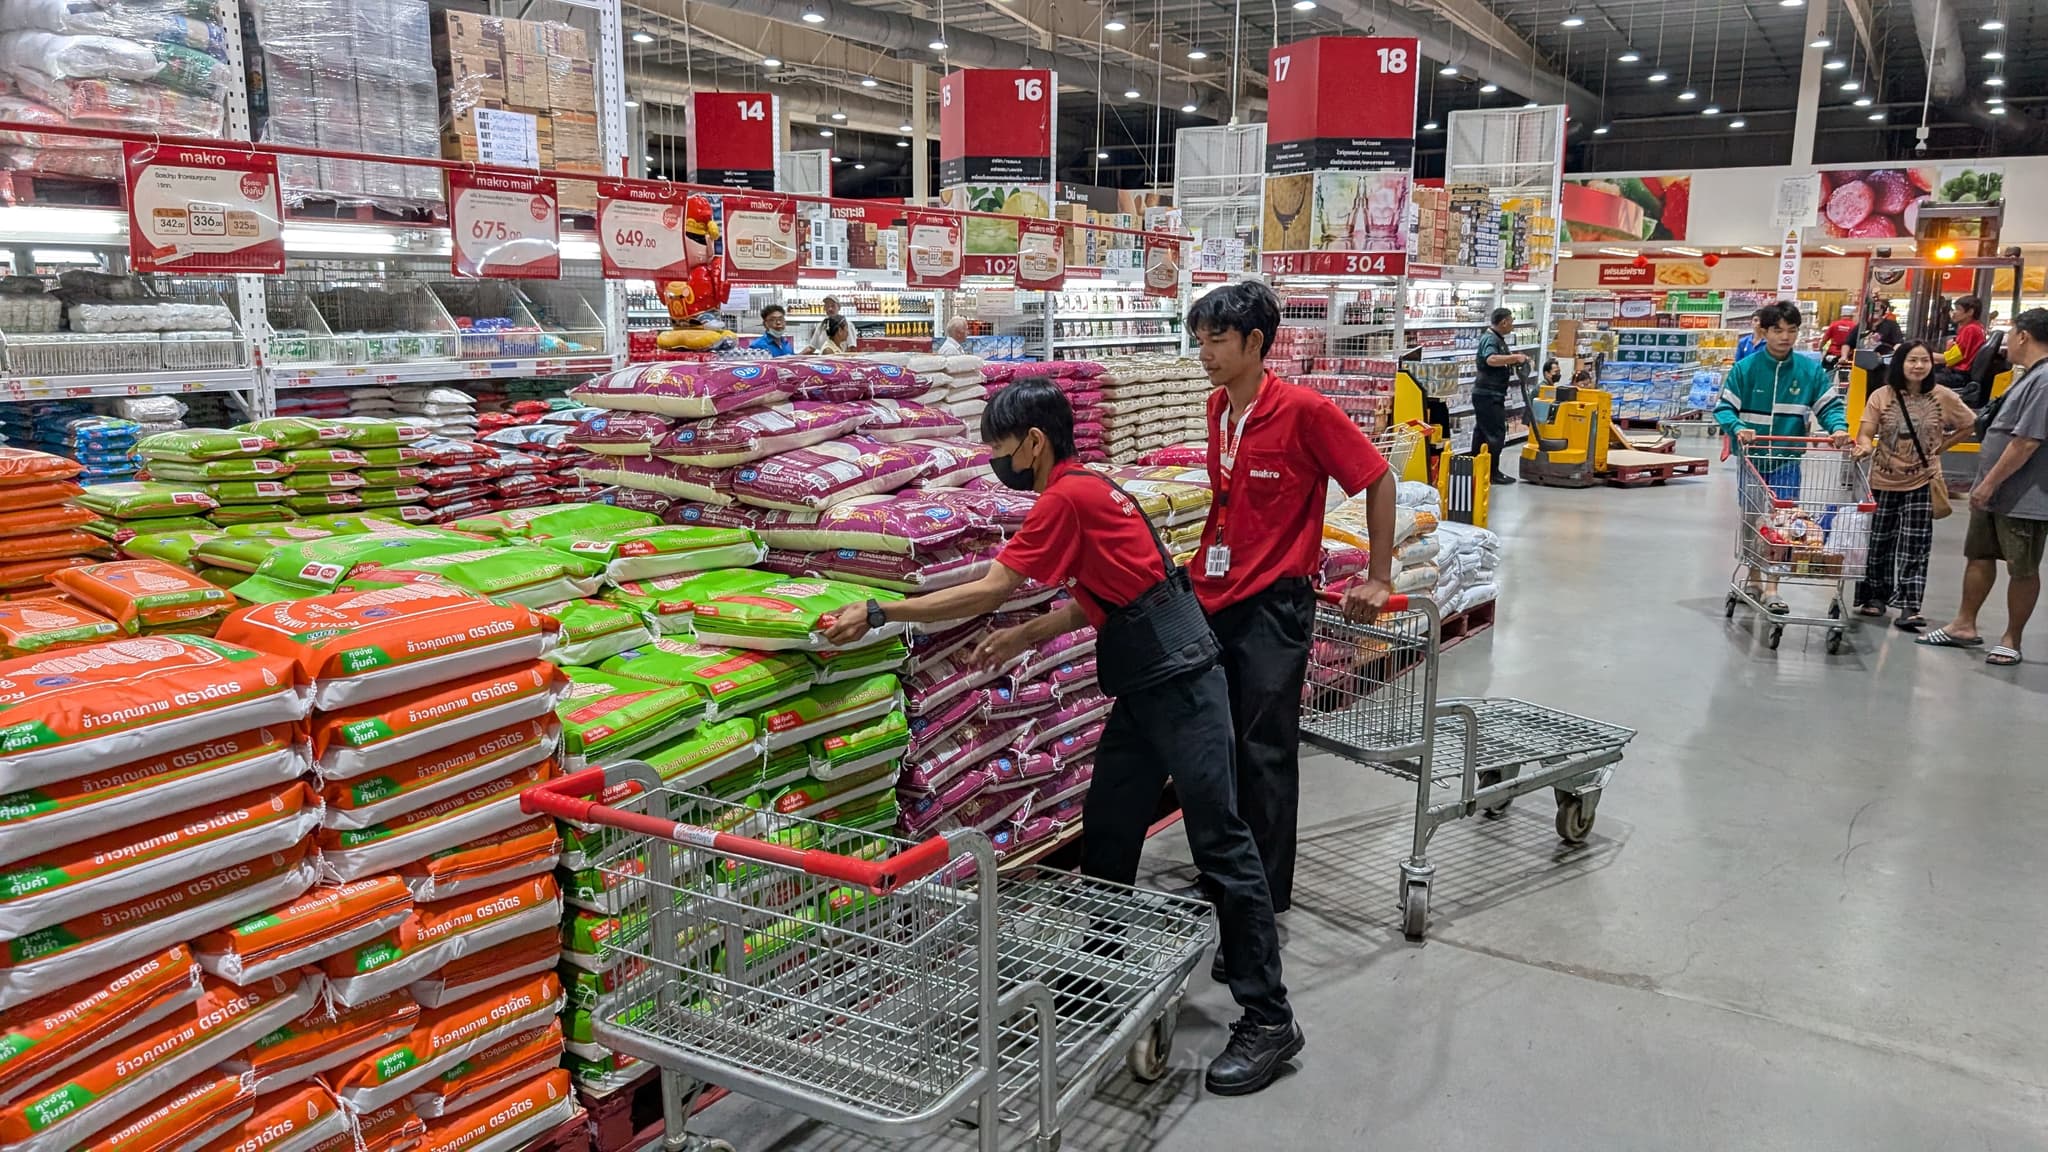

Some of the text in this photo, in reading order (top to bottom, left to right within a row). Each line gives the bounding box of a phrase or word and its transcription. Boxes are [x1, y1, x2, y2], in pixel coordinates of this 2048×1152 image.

[1274, 56, 1291, 82] 17
[1377, 48, 1407, 74] 18
[943, 84, 951, 107] 15
[1014, 79, 1043, 101] 16
[737, 101, 765, 121] 14
[180, 152, 226, 166] makro
[476, 175, 532, 190] makro mail
[630, 188, 656, 200] makro
[750, 200, 773, 210] makro
[193, 215, 223, 227] 336.00
[472, 219, 522, 241] 675.00
[616, 228, 656, 249] 649.00
[984, 258, 1016, 274] 102
[1346, 255, 1386, 273] 304
[1249, 469, 1280, 479] makro
[407, 619, 516, 653] ข้าวคุณภาพ ตราฉัตร
[82, 680, 241, 729] ข้าวคุณภาพ ตราฉัตร
[408, 681, 518, 723] ข้าวคุณภาพ ตราฉัตร
[82, 740, 239, 793] ข้าวคุณภาพ ตราฉัตร
[417, 731, 524, 779] ข้าวคุณภาพ ตราฉัตร
[95, 808, 250, 865] ข้าวคุณภาพ ตราฉัตร
[103, 865, 251, 927] ข้าวคุณภาพ ตราฉัตร
[416, 895, 521, 942] ข้าวคุณภาพ ตราฉัตร
[432, 995, 532, 1049] ข้าวคุณภาพ ตราฉัตร
[116, 1027, 195, 1077] ข้าวคุณภาพ
[199, 992, 261, 1032] ตราฉัตร
[489, 1098, 533, 1128] ตราฉัตร
